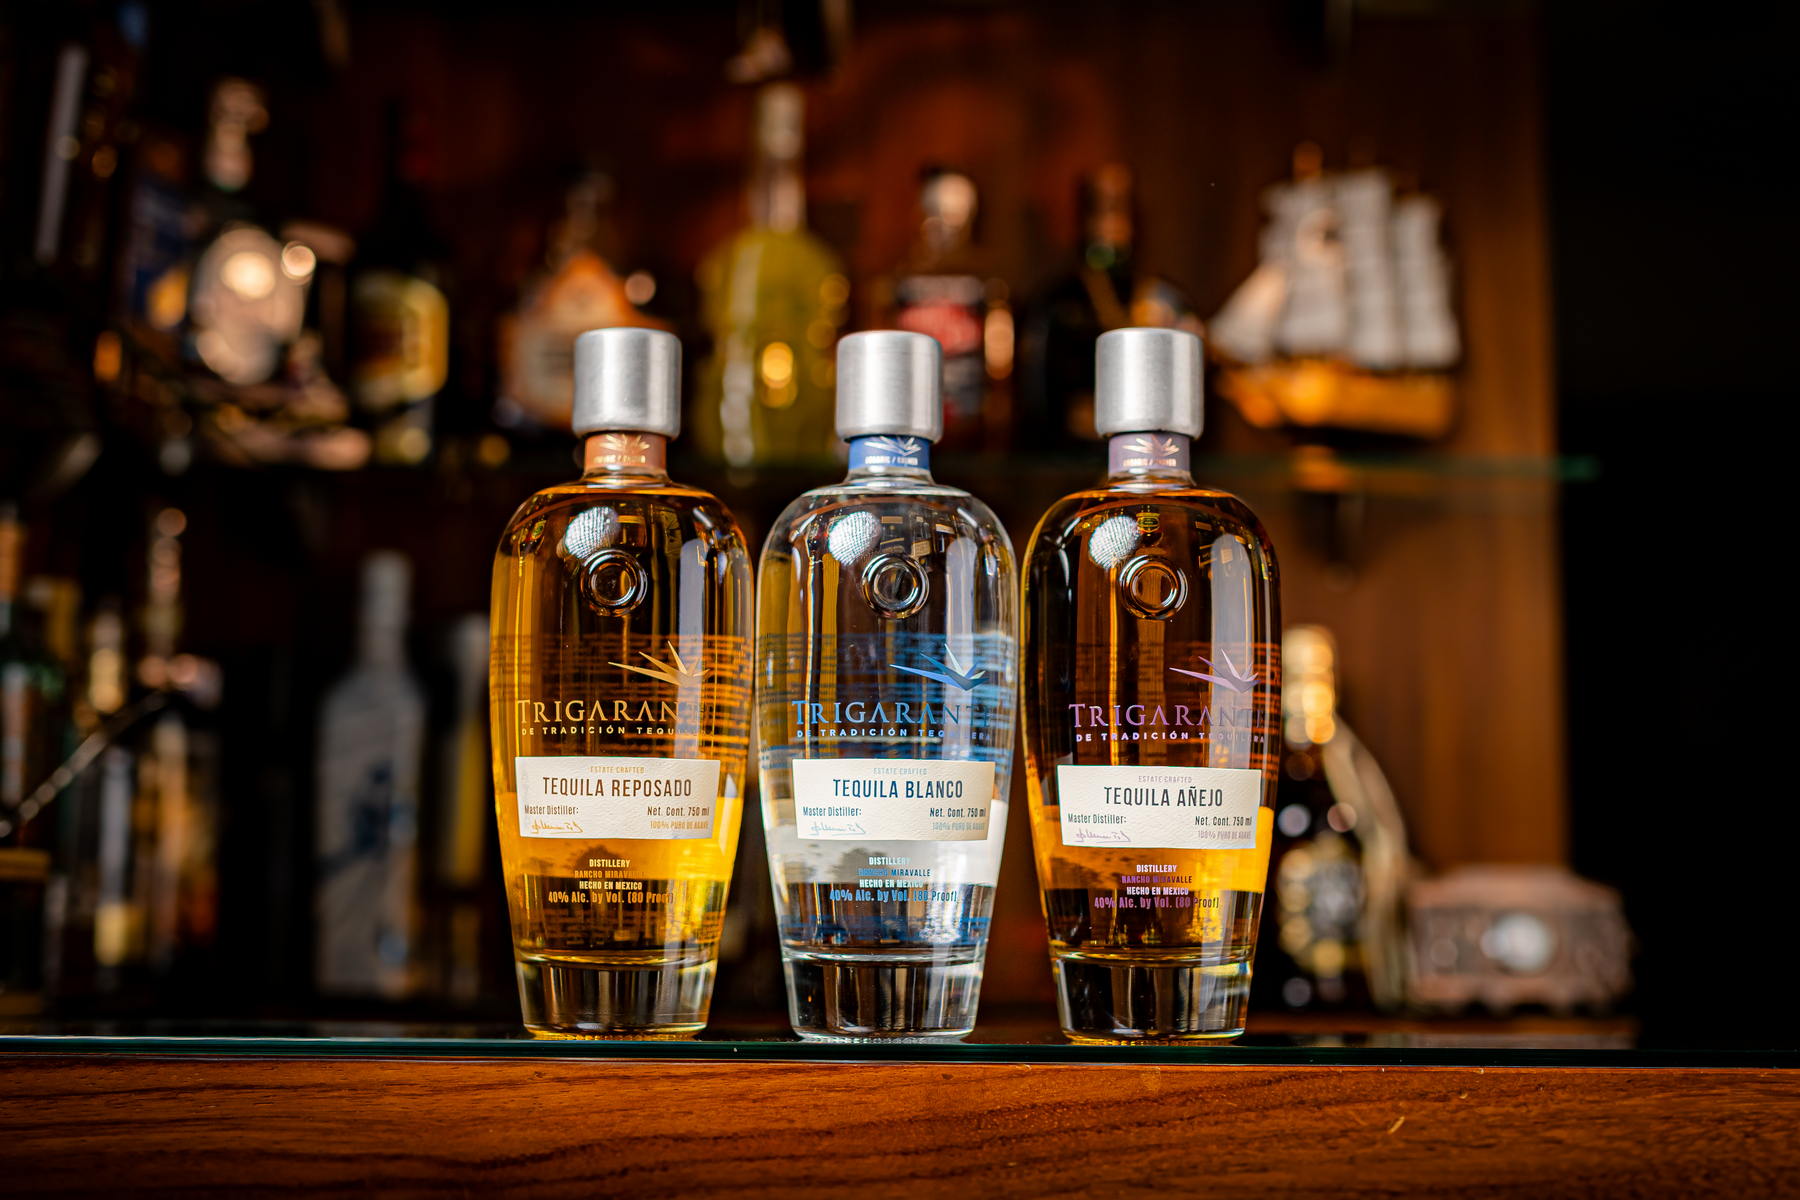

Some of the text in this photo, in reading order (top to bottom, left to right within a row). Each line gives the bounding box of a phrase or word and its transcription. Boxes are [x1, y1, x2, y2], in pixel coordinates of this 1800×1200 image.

[521, 728, 535, 736] DE
[542, 724, 626, 736] TRADICIÓN
[796, 729, 812, 738] DE
[820, 727, 908, 738] TRADICIÓN
[1075, 733, 1092, 742] DE
[1101, 730, 1190, 742] TRADICIÓN
[543, 776, 692, 797] TEQUILA REPOSADO
[833, 778, 963, 798] TEQUILA BLANCO
[1104, 786, 1223, 807] TEQUILA AÑEJO
[524, 804, 579, 816] Master Distiller:
[647, 806, 710, 817] Net. Cont. 750 ml
[803, 806, 862, 817] Master Distiller:
[929, 807, 945, 818] Net.
[947, 808, 965, 818] Cont.
[967, 808, 978, 818] 750
[1067, 812, 1127, 825] Master Distiller:
[1194, 815, 1211, 826] Net.
[1212, 816, 1231, 826] Cont.
[1233, 816, 1244, 826] 750
[589, 858, 631, 868] DISTILLERY
[868, 856, 911, 866] DISTILLERY
[891, 868, 931, 877] MIRAVALLE
[1136, 864, 1177, 873] DISTILLERY
[574, 870, 603, 879] RANCHO
[579, 881, 643, 890] HECHO EN MEXICO
[859, 878, 924, 888] HECHO EN MEXICO
[829, 889, 853, 902] 40%
[855, 889, 875, 902] Alc.
[877, 889, 889, 903] by
[1126, 886, 1189, 895] HECHO EN MEXICO
[548, 891, 569, 903] 40%
[571, 891, 589, 903] Alc.
[592, 891, 602, 904] by
[605, 891, 624, 903] Vol.
[1094, 897, 1116, 909] 40%
[1119, 897, 1137, 909] Alc.
[1140, 897, 1152, 910] by
[1154, 897, 1173, 909] Vol.
